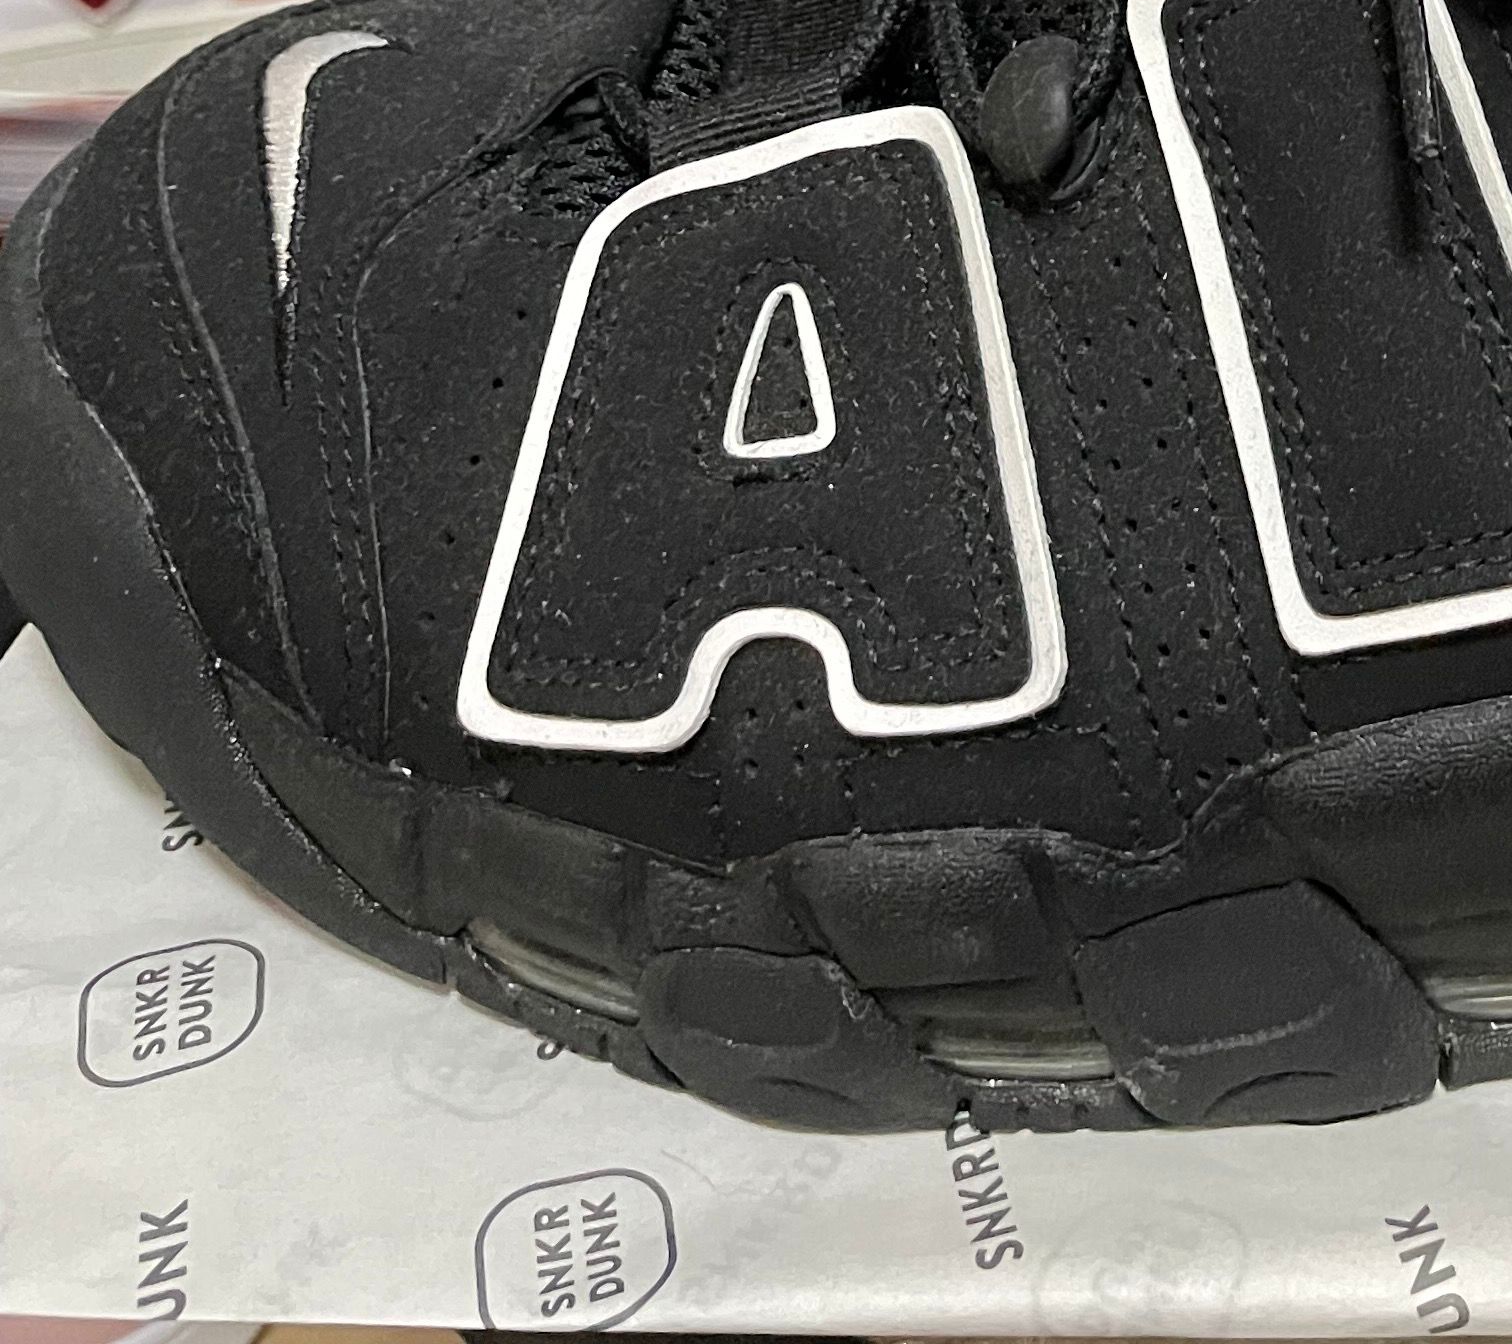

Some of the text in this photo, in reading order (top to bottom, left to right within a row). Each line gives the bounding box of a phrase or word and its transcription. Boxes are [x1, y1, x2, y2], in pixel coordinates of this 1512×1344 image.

[133, 966, 171, 1062] SNKR
[178, 955, 217, 1051] DUNK
[137, 1198, 189, 1321] UNK
[534, 1204, 576, 1318] SNKR
[580, 1191, 625, 1303] DUNK
[1384, 1203, 1471, 1334] UNK
